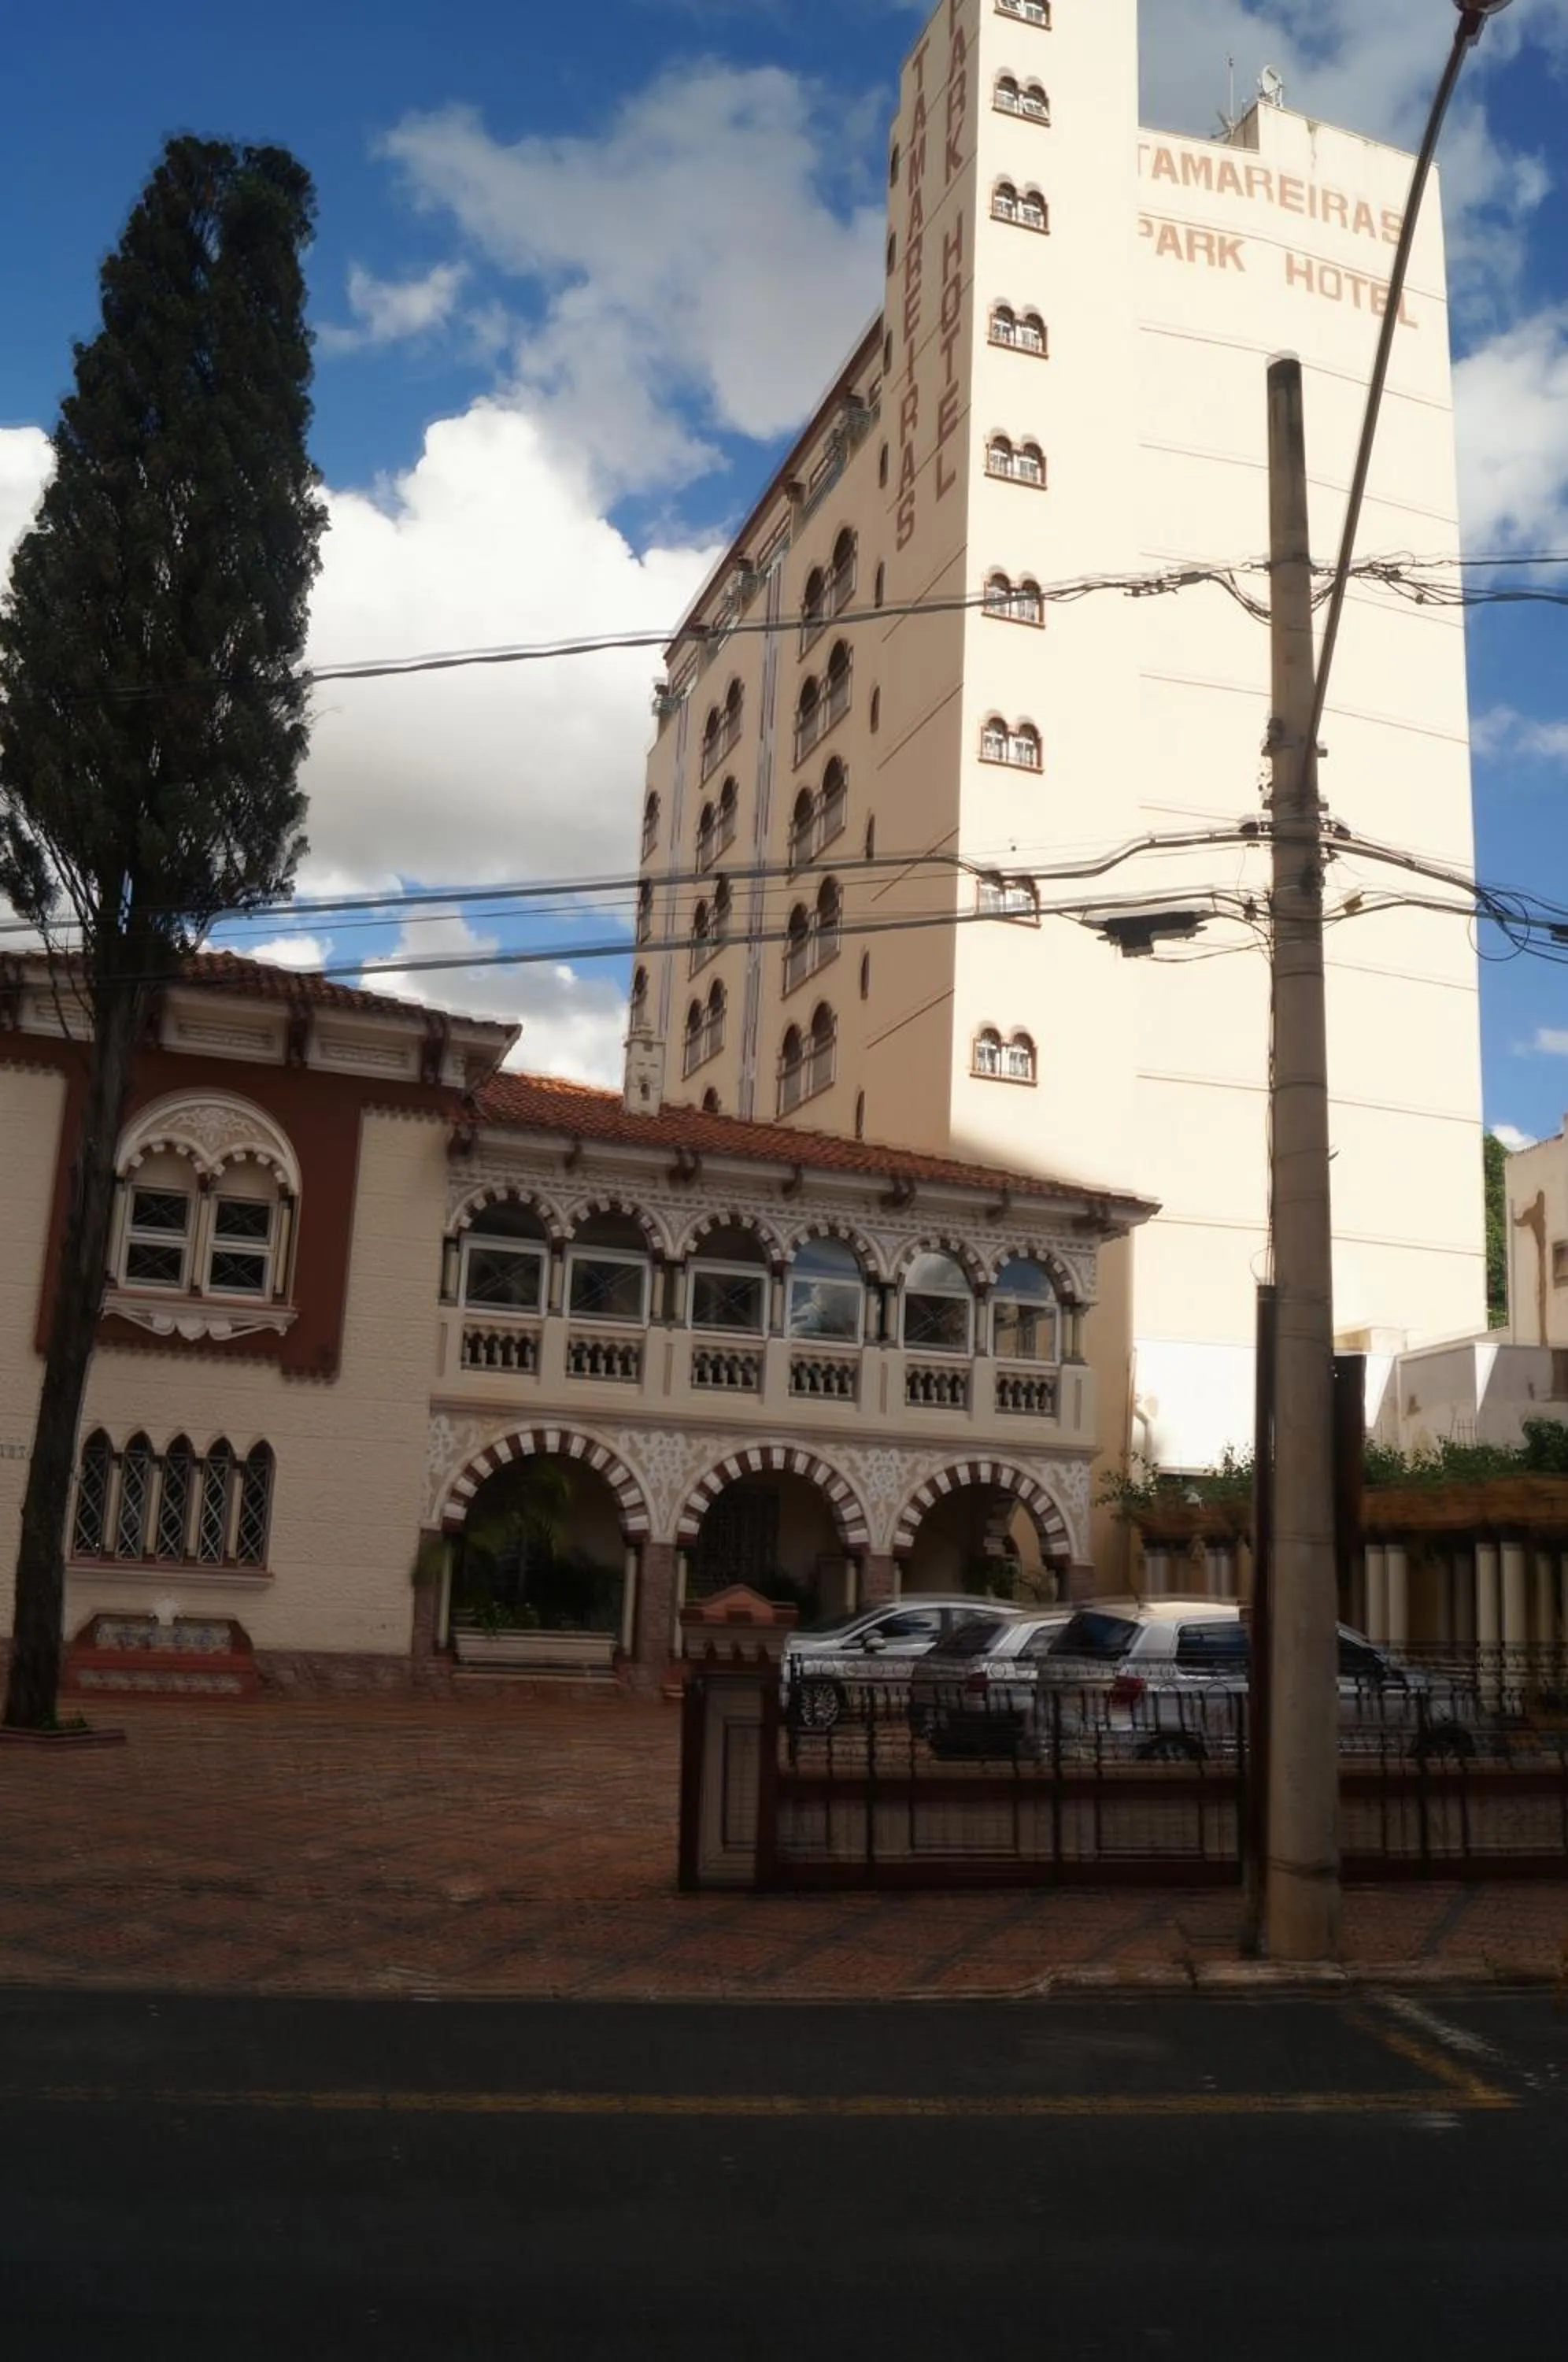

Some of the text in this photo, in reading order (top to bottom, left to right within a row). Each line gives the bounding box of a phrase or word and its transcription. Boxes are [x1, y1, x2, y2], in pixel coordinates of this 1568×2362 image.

[897, 37, 930, 552] TAMAREIRAS
[935, 209, 963, 503] HOTEL
[1285, 251, 1418, 329] HOTEL
